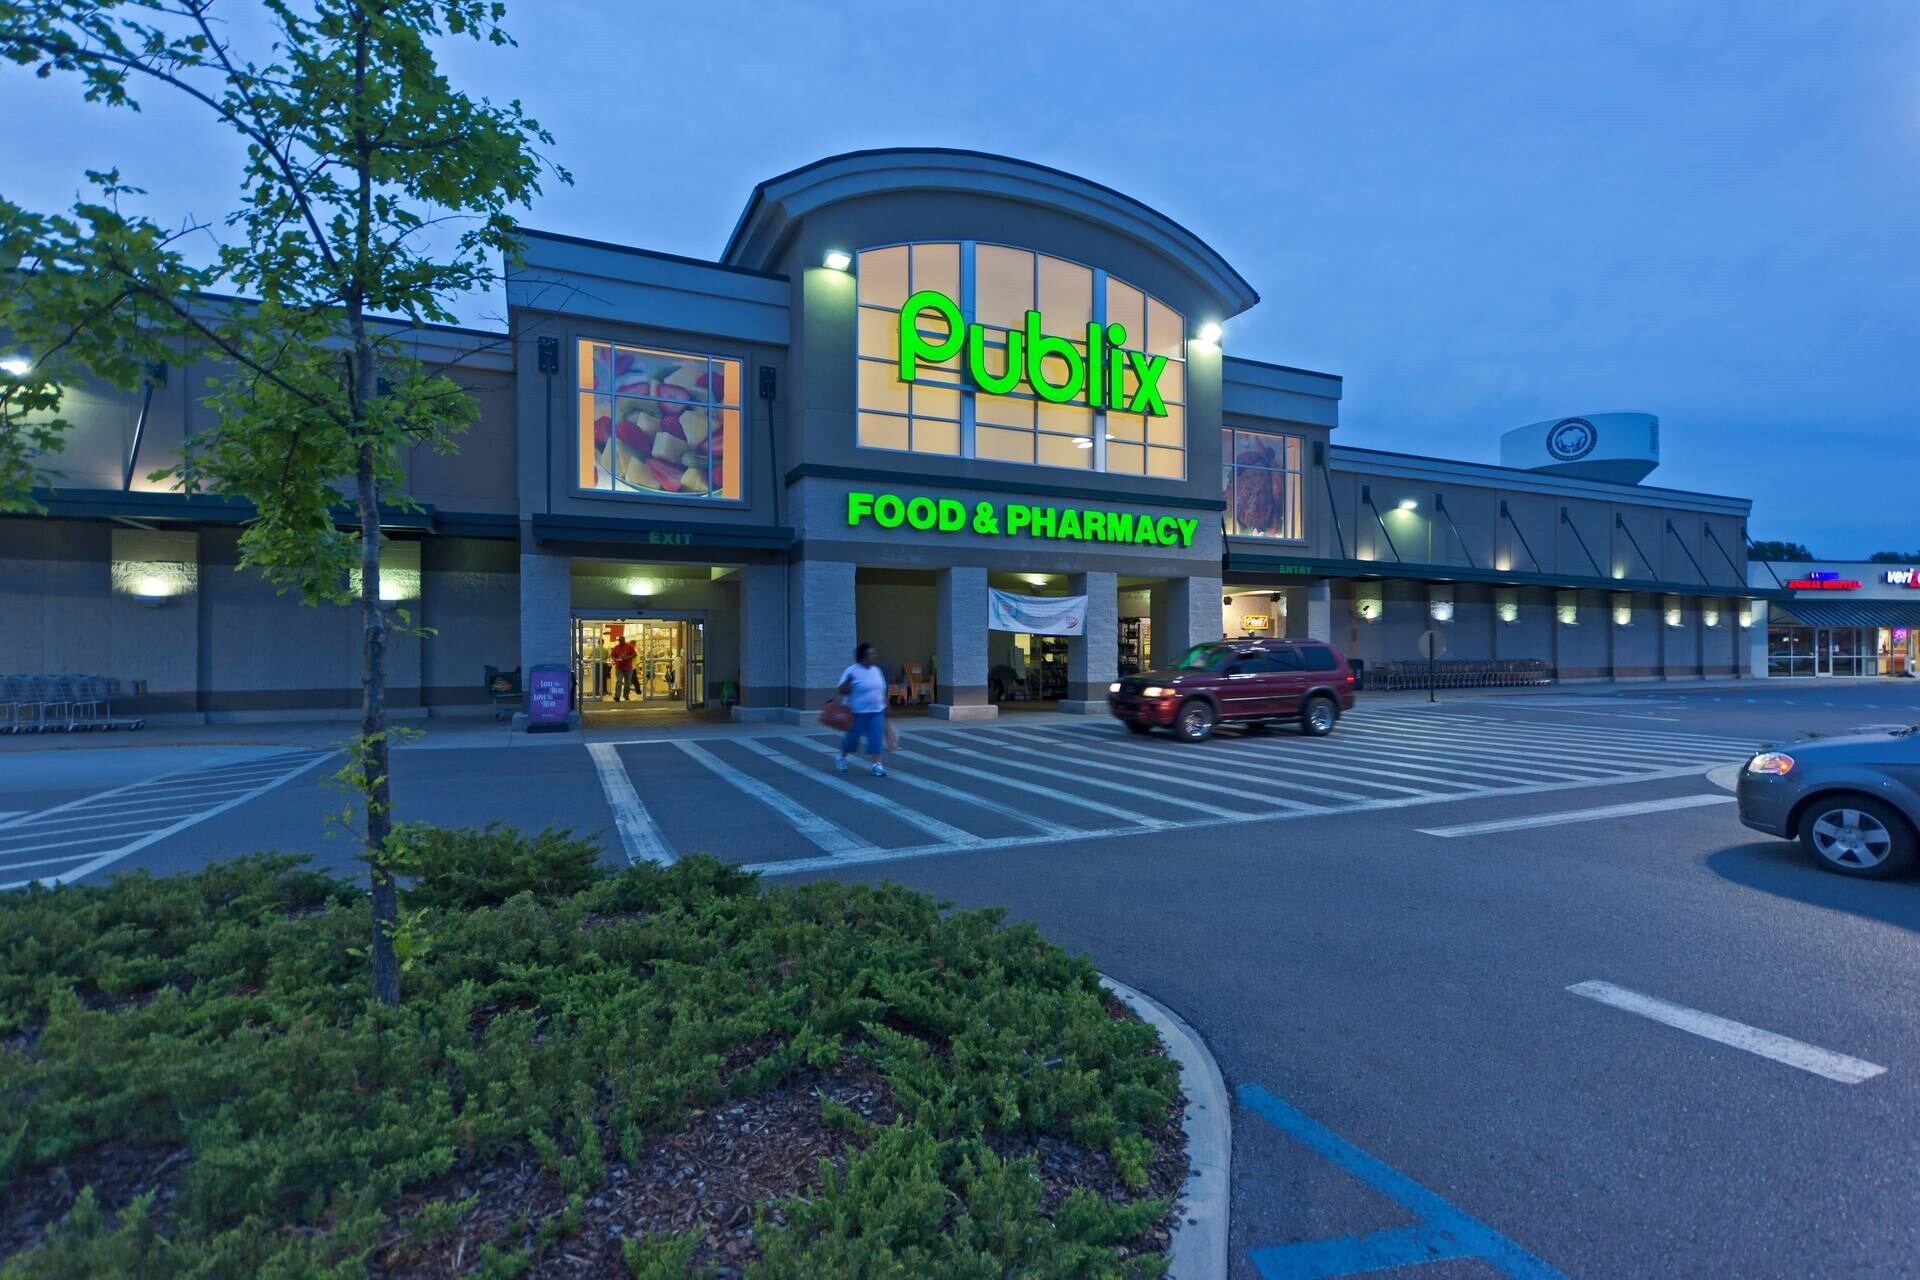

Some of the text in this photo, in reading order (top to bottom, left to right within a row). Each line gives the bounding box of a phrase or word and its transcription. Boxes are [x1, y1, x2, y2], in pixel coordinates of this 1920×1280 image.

[899, 290, 1168, 418] Publix
[848, 492, 1199, 547] FOOD & PHARMACY
[649, 532, 693, 545] EXIT
[1279, 564, 1312, 575] ENTRY
